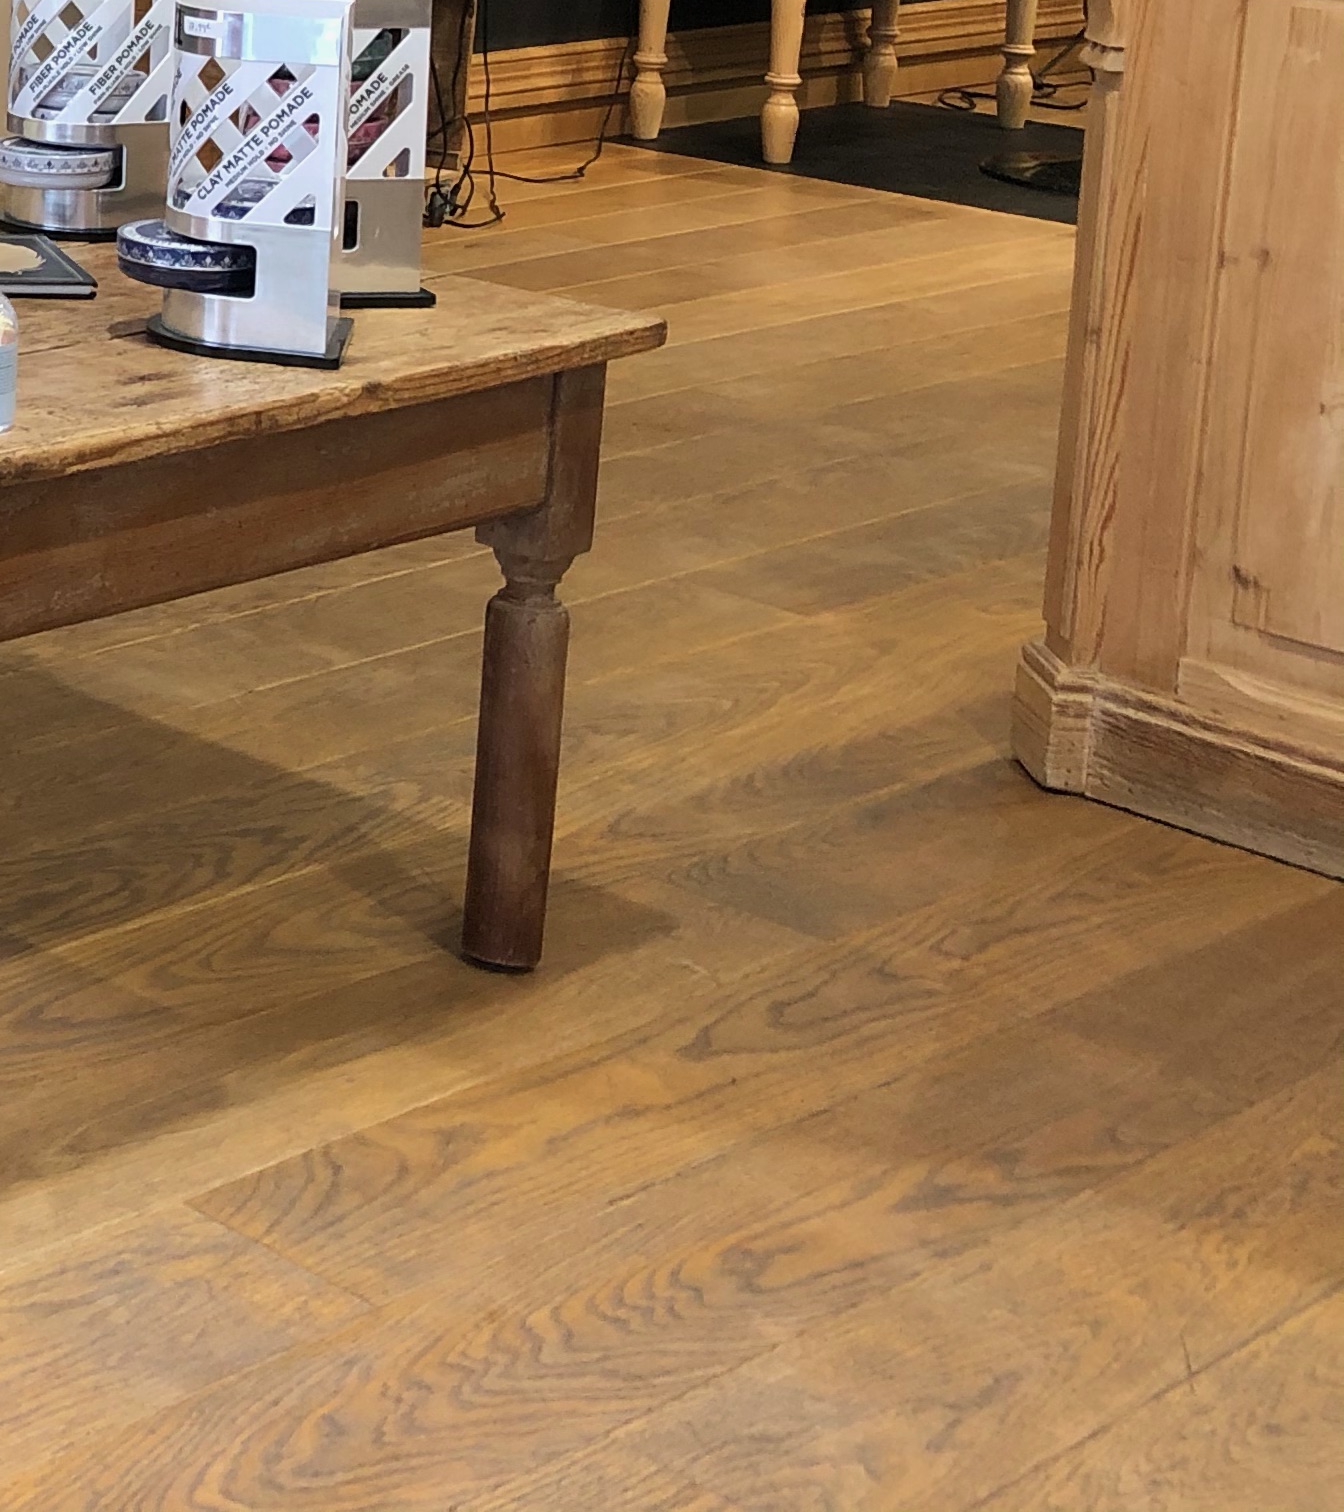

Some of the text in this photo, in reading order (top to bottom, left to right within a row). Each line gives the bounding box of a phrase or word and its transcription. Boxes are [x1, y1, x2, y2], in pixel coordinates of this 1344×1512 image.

[13, 14, 40, 55] POMADE
[29, 21, 94, 93] FIBER POMADE
[88, 19, 156, 96] FIBER POMADE
[171, 83, 234, 164] MATTE POMADE
[349, 72, 388, 116] OMADE
[350, 110, 372, 129] MEDIUM
[197, 86, 314, 200] CLAY MATTE POMADE
[224, 119, 297, 188] MEDIUM HOLD NO SHINE
